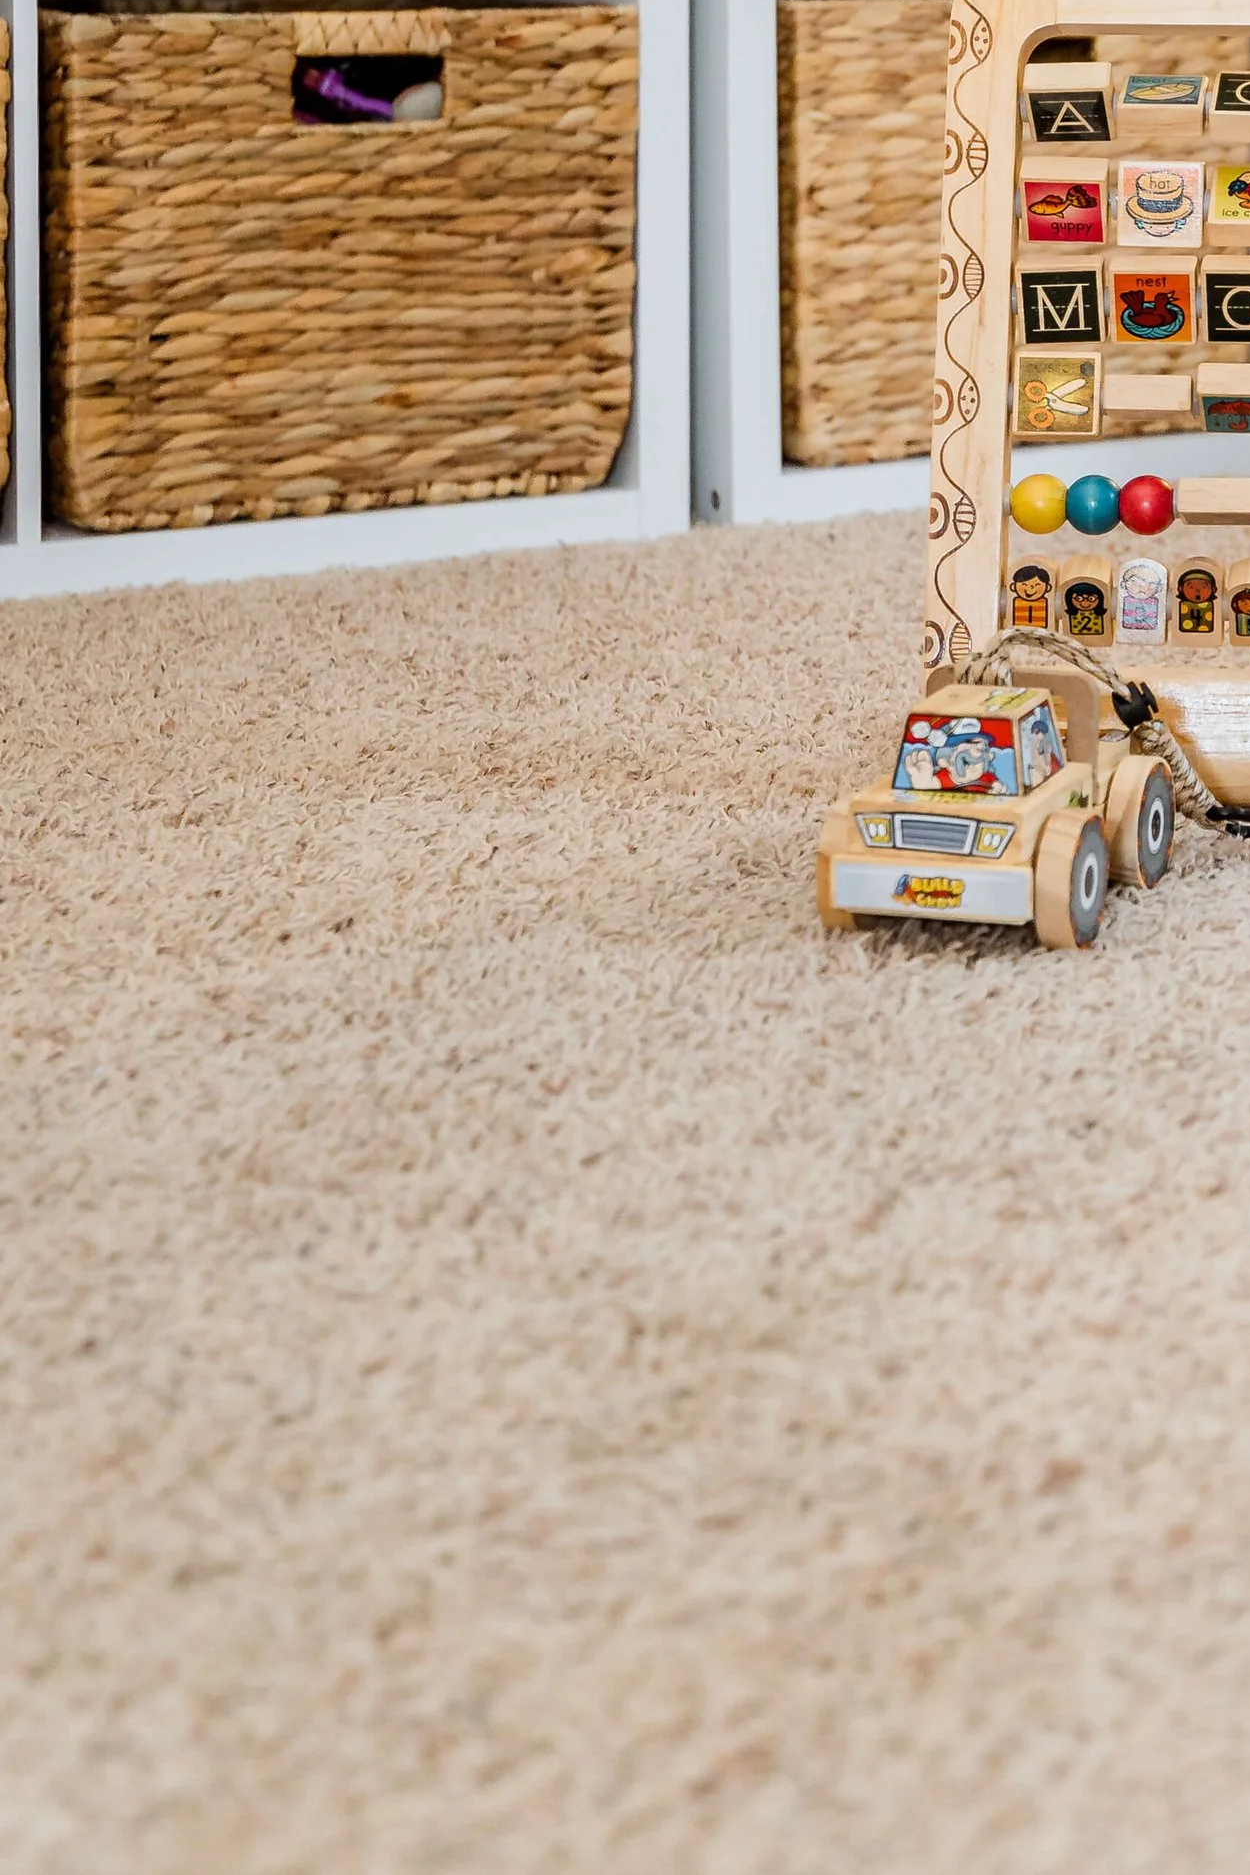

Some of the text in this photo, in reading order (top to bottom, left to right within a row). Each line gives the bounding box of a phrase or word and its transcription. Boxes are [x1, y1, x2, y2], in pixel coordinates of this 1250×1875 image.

[1050, 101, 1095, 134] A
[1149, 175, 1172, 191] hat
[1221, 208, 1239, 218] ice
[1051, 220, 1092, 237] guppy
[1136, 276, 1167, 288] nest
[1037, 285, 1085, 330] M
[1027, 605, 1033, 623] 1
[1189, 608, 1201, 624] 4
[1081, 616, 1092, 632] 2
[911, 877, 965, 894] BUILD
